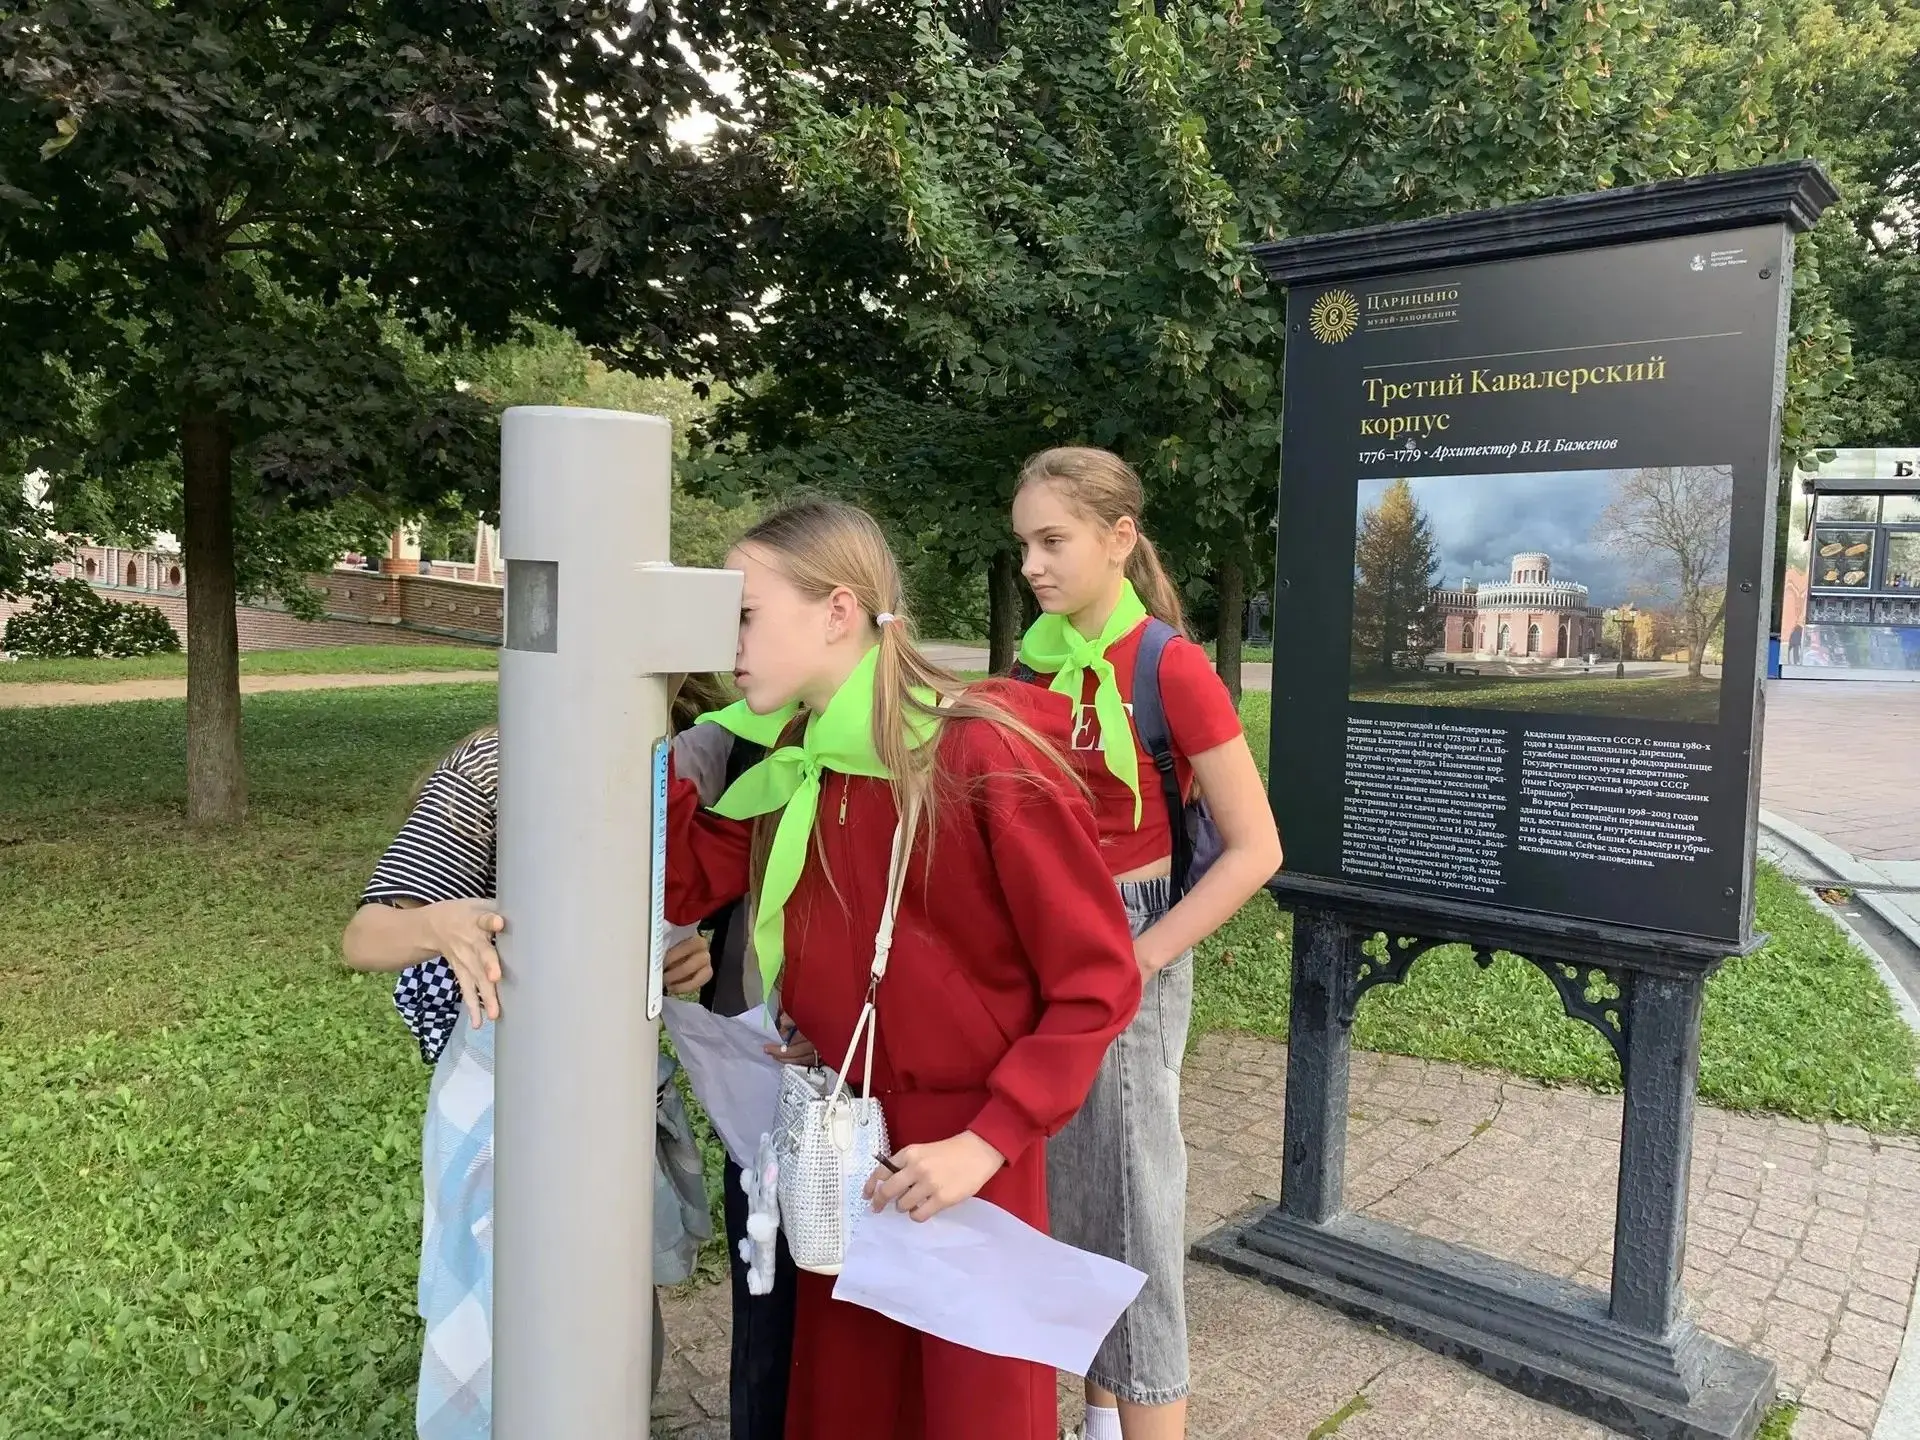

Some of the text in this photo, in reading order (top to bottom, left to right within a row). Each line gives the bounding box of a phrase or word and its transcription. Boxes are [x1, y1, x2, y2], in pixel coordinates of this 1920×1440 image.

[1363, 355, 1666, 407] Третий Кавалерский
[1360, 413, 1450, 439] корпус
[1429, 442, 1517, 459] Архитектор
[1554, 438, 1618, 452] Баженов
[1524, 730, 1565, 740] Академии
[1567, 734, 1611, 744] художеств
[1653, 740, 1679, 748] конца
[1683, 740, 1710, 751] 1980-х
[1554, 743, 1584, 751] здании
[1587, 745, 1637, 755] находились
[1523, 749, 1712, 772] служебные помещения фондохранилище
[1523, 758, 1597, 773] Государственного
[1599, 766, 1624, 775] музея
[1522, 769, 1689, 788] прикладного искусства народов СССР
[1521, 777, 1708, 803] (ныне Государственный музей-заповедник
[1520, 807, 1694, 832] зданию был возвращён первоначальный
[1532, 797, 1542, 805] Во
[1544, 800, 1568, 809] время
[1571, 802, 1625, 814] реставрации
[1673, 812, 1698, 821] годов
[1537, 828, 1561, 837] своды
[1597, 833, 1672, 850] башня-бельведер
[1538, 819, 1601, 831] восстановлены
[1603, 826, 1656, 838] внутренняя
[1518, 835, 1536, 843] ство
[1576, 840, 1606, 851] Сейчас
[1608, 846, 1631, 854] здесь
[1633, 848, 1694, 862] размещаются
[1518, 845, 1567, 857] экспозиции
